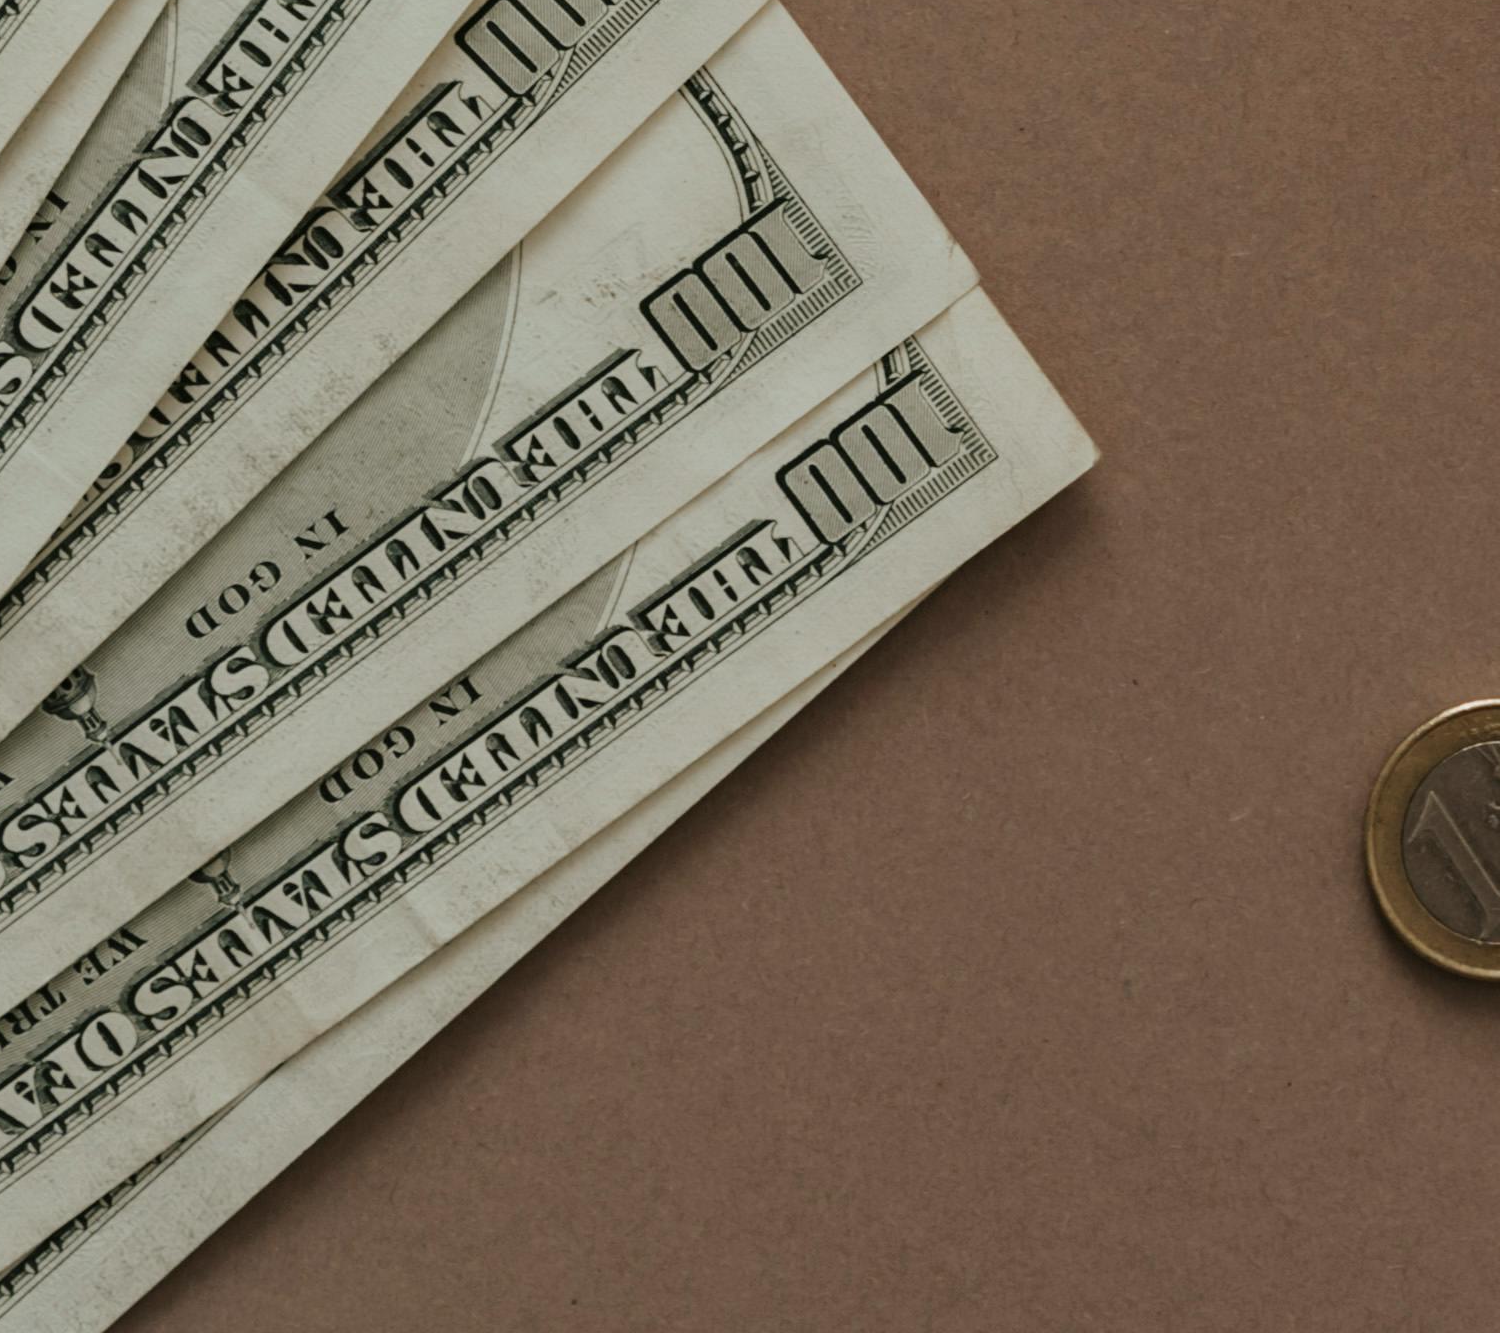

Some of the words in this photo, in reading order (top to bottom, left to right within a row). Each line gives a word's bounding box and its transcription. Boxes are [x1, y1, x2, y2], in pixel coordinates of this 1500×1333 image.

[0, 82, 230, 368] UNITED
[325, 65, 496, 246] THE
[634, 191, 838, 379] 100
[493, 339, 668, 492] THE
[769, 365, 973, 548] 100
[178, 553, 286, 645] GOD
[241, 444, 526, 683] UNITED
[289, 505, 350, 561] IN
[626, 511, 805, 661] THE
[310, 720, 420, 810] GOD
[378, 612, 668, 841] UNITED
[423, 673, 483, 727] IN
[70, 920, 146, 986] WE
[111, 801, 410, 1037] STATES
